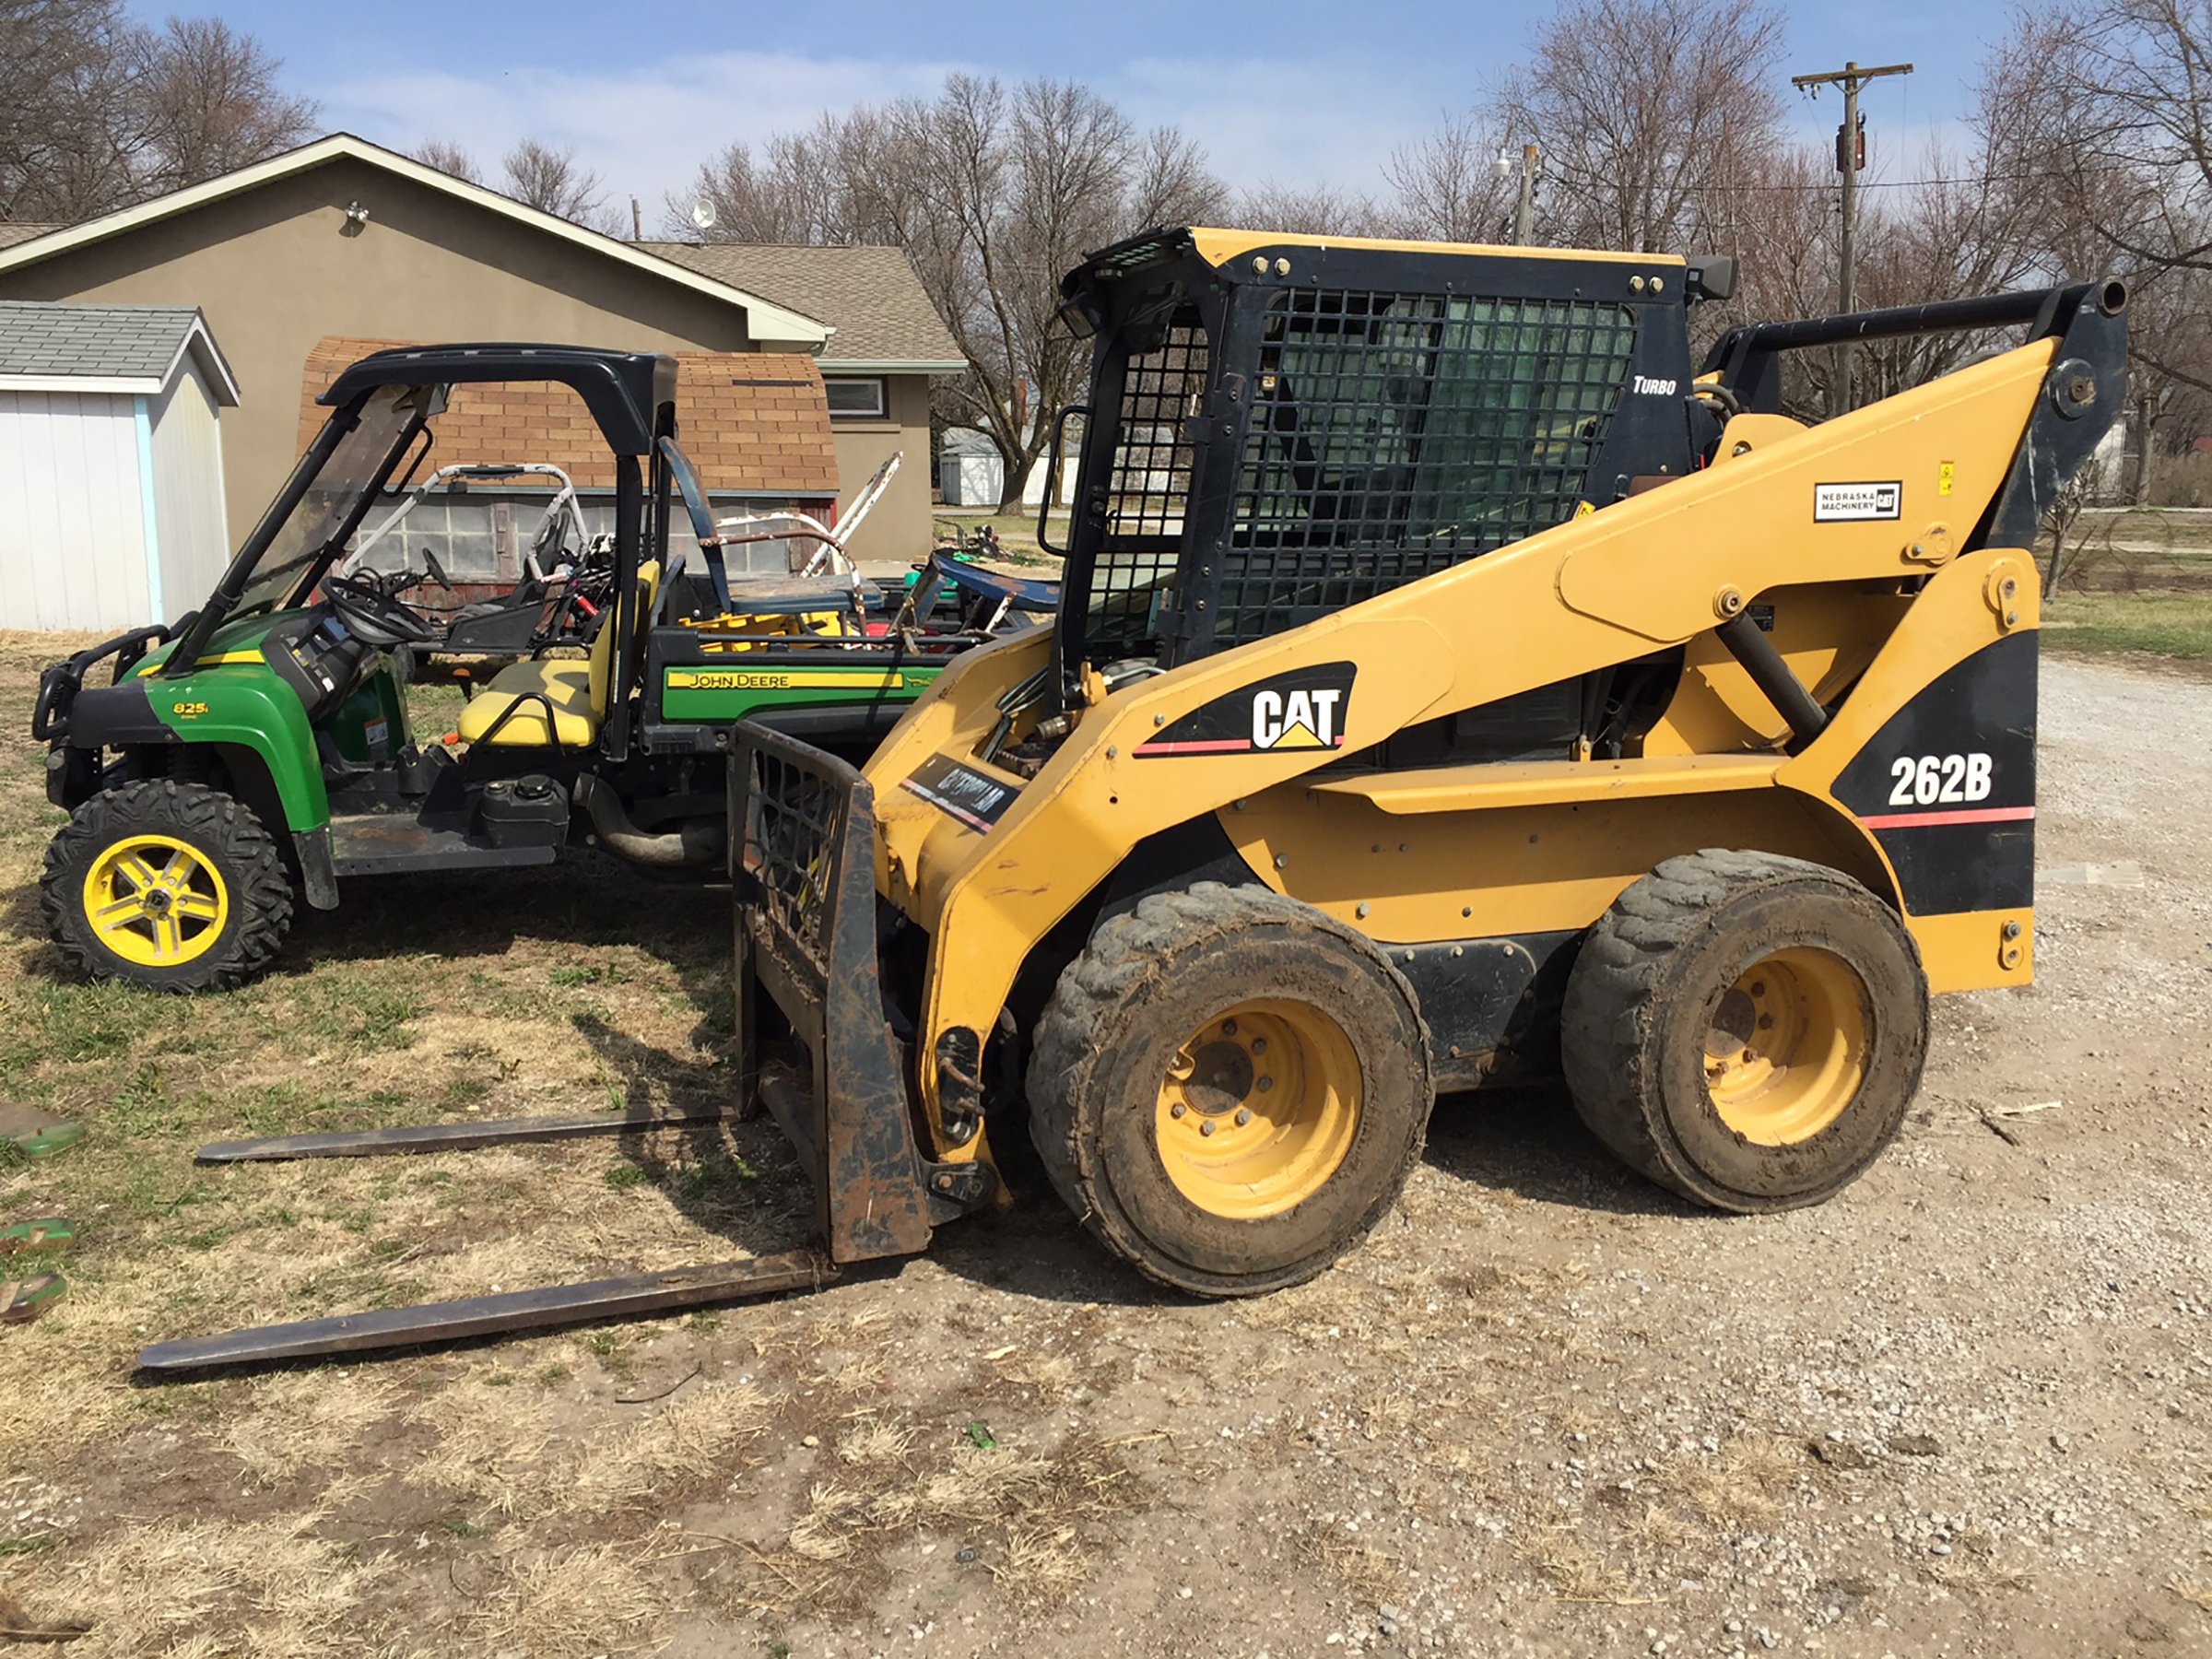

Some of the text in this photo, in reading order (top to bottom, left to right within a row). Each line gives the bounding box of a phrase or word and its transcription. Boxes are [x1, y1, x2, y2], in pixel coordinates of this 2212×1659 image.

[1822, 492, 1875, 501] NEBRASKA
[1821, 502, 1874, 511] MACHINERY
[690, 674, 789, 687] JOHN DEERE
[1253, 689, 1342, 749] CAT
[1888, 752, 1993, 806] 262B
